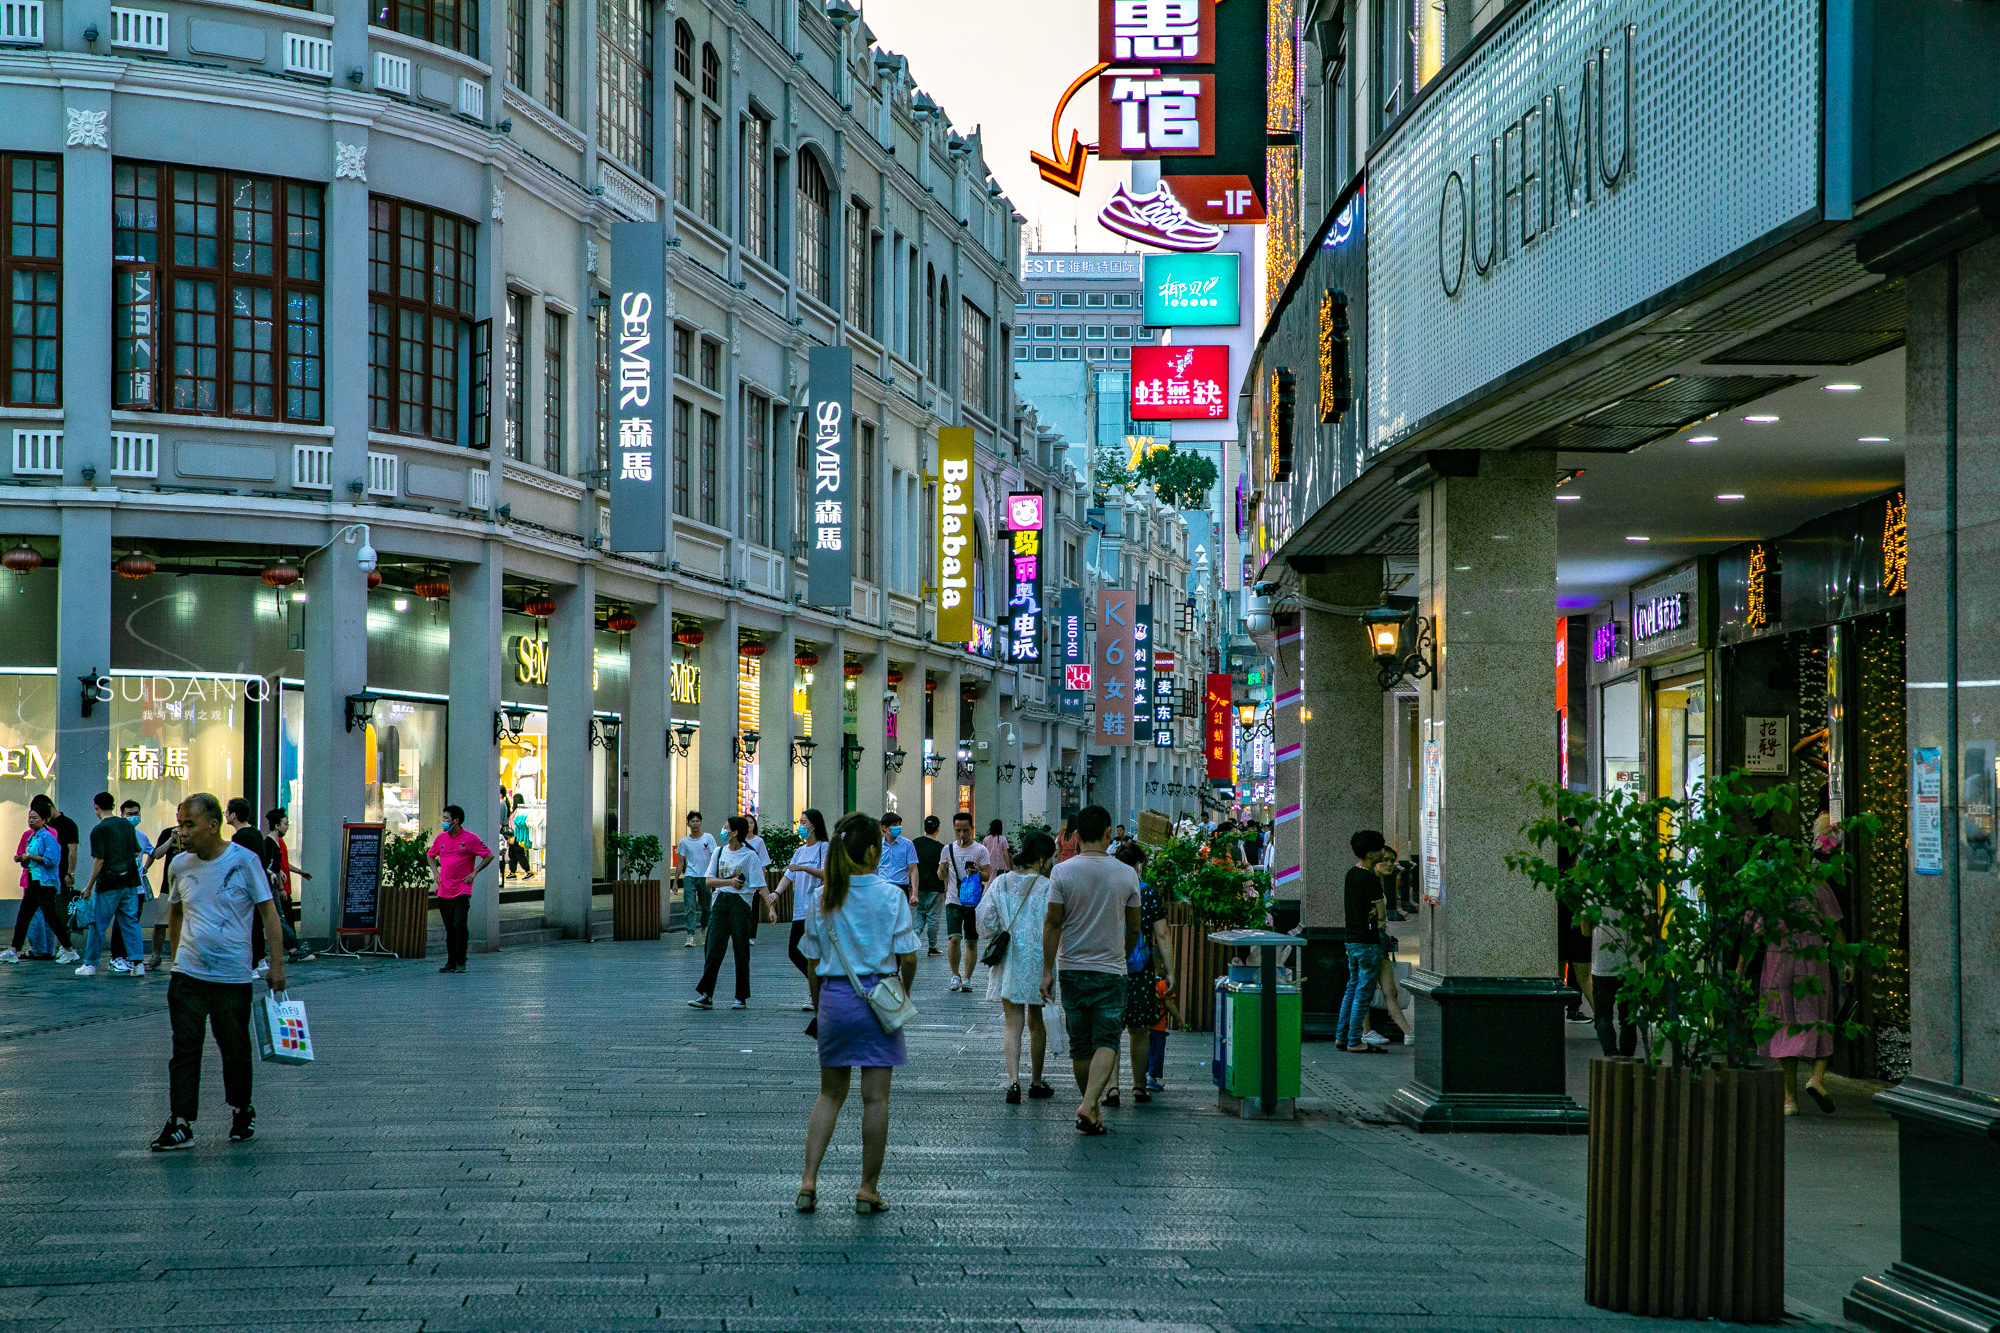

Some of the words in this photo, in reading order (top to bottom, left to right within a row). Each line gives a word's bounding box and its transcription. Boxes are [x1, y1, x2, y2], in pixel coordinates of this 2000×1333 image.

[620, 292, 652, 410] SEMIR
[1135, 378, 1223, 405] 蛙無缺
[1208, 405, 1224, 416] 5F
[619, 417, 653, 481] 森馬
[816, 401, 842, 494] SEMIR
[815, 500, 842, 550] 森馬
[942, 458, 968, 610] Balabala
[1010, 530, 1042, 660] 玛丽奥电玩
[1156, 680, 1172, 745] 麦东尼
[1759, 719, 1781, 757] 招聘
[125, 745, 190, 781] 森馬
